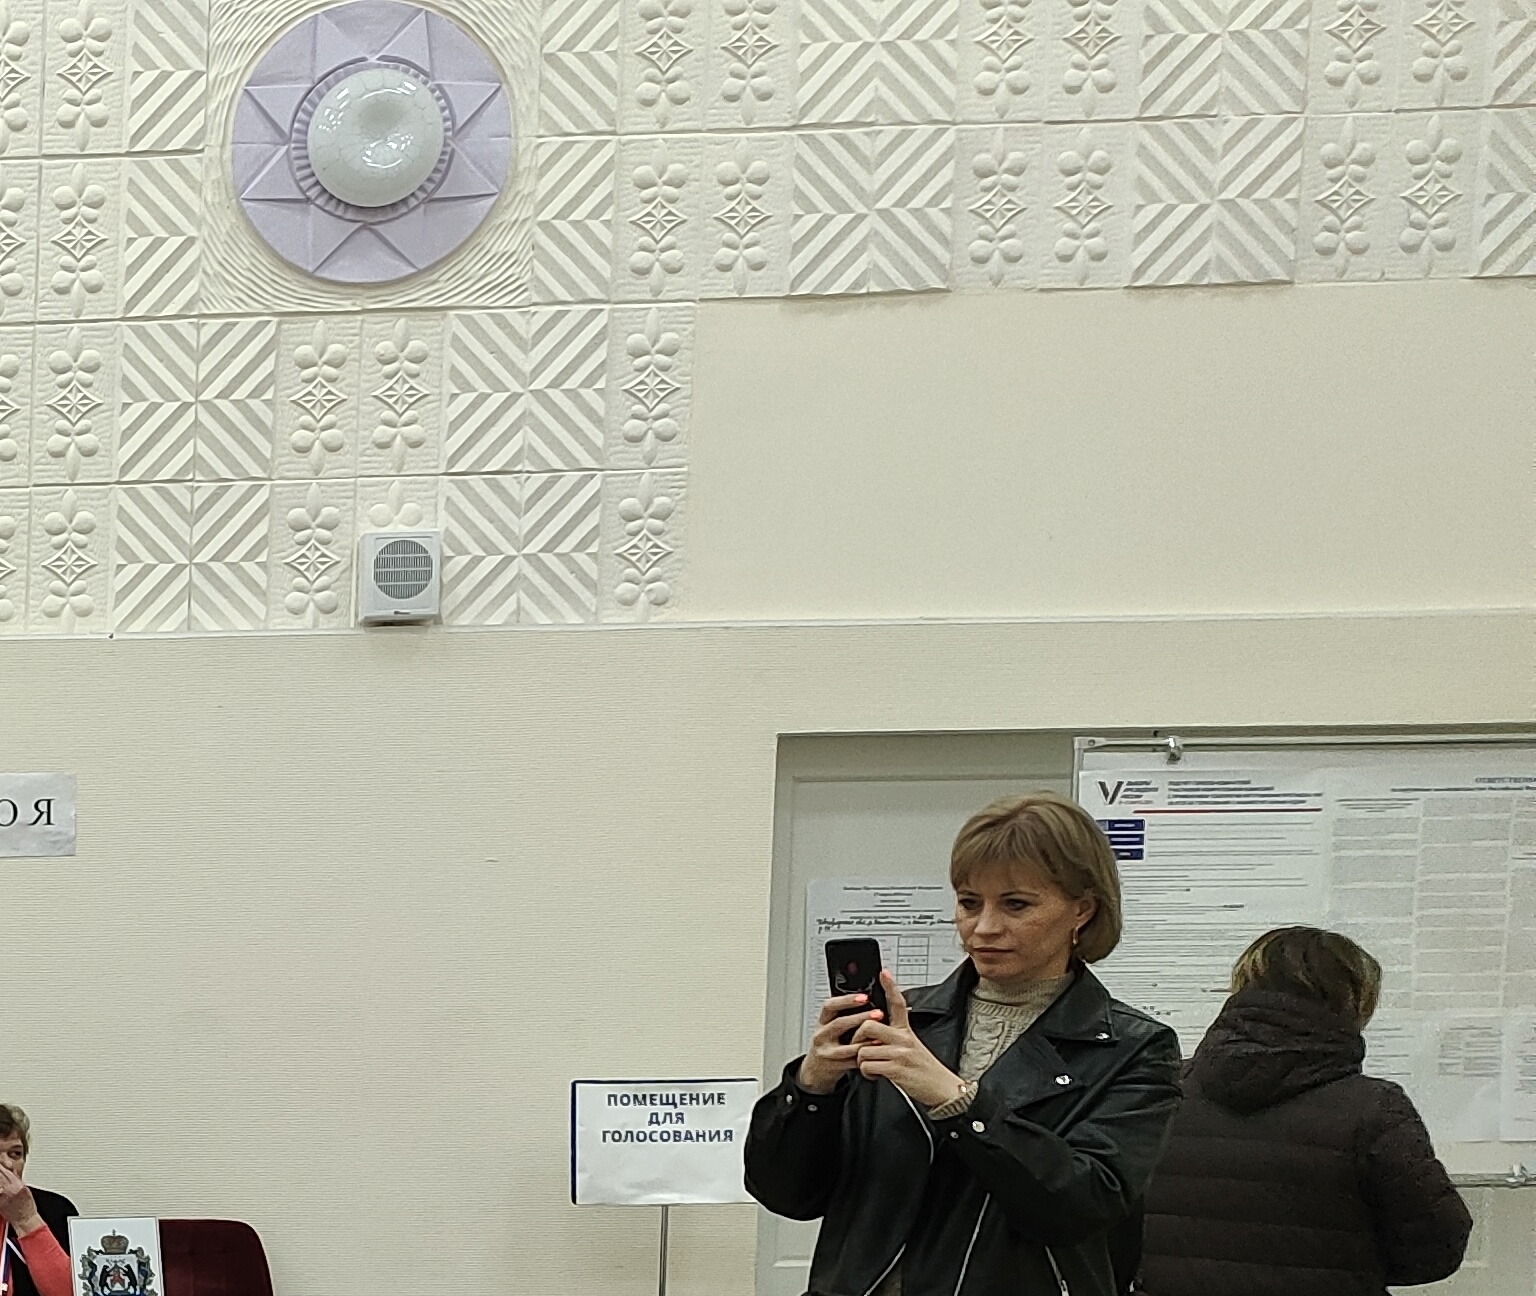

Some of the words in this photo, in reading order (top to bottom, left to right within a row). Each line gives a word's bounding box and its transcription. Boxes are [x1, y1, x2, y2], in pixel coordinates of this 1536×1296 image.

[606, 1092, 727, 1109] ПОМЕЩЕНИЕ
[647, 1111, 686, 1127] ДЛЯ
[601, 1129, 734, 1144] ГОЛОСОВАНИЯ
